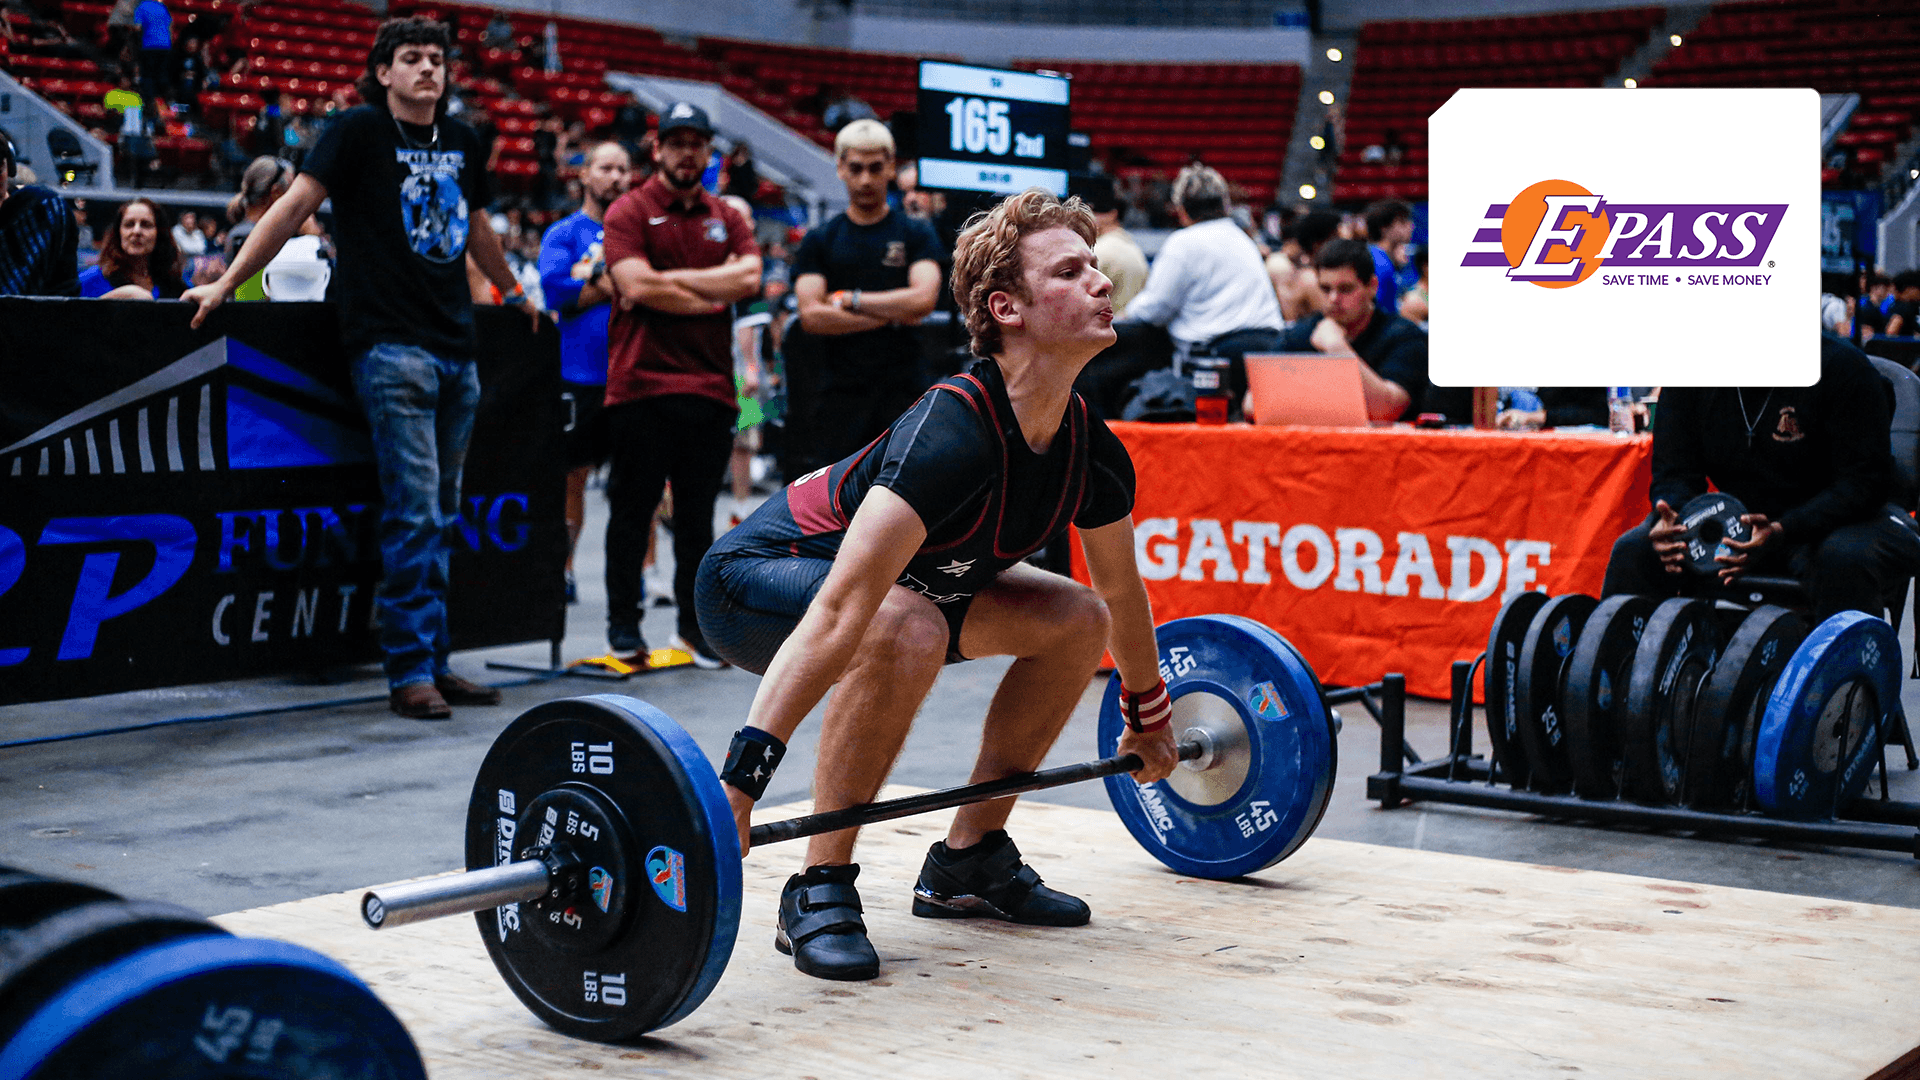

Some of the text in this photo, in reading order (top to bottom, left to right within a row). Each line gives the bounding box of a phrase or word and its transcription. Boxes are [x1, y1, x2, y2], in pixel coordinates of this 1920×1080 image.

[944, 96, 1046, 159] 165 2nd
[214, 492, 530, 573] FUNNG
[1135, 516, 1552, 603] GATORADE
[213, 581, 386, 646] CENT
[1169, 646, 1197, 677] 45
[1861, 636, 1878, 666] 45
[1506, 660, 1516, 733] DYNAMIC
[1541, 704, 1557, 734] 25
[571, 741, 586, 773] LBS
[588, 741, 614, 775] 10
[566, 810, 580, 836] LBS
[580, 820, 600, 842] 5
[1234, 812, 1255, 839] LBS
[1250, 800, 1279, 832] 45
[499, 817, 520, 932] DYNIC
[563, 911, 582, 930] 5
[583, 970, 598, 1003] LBS
[600, 972, 627, 1007] 10
[195, 1004, 252, 1062] 45
